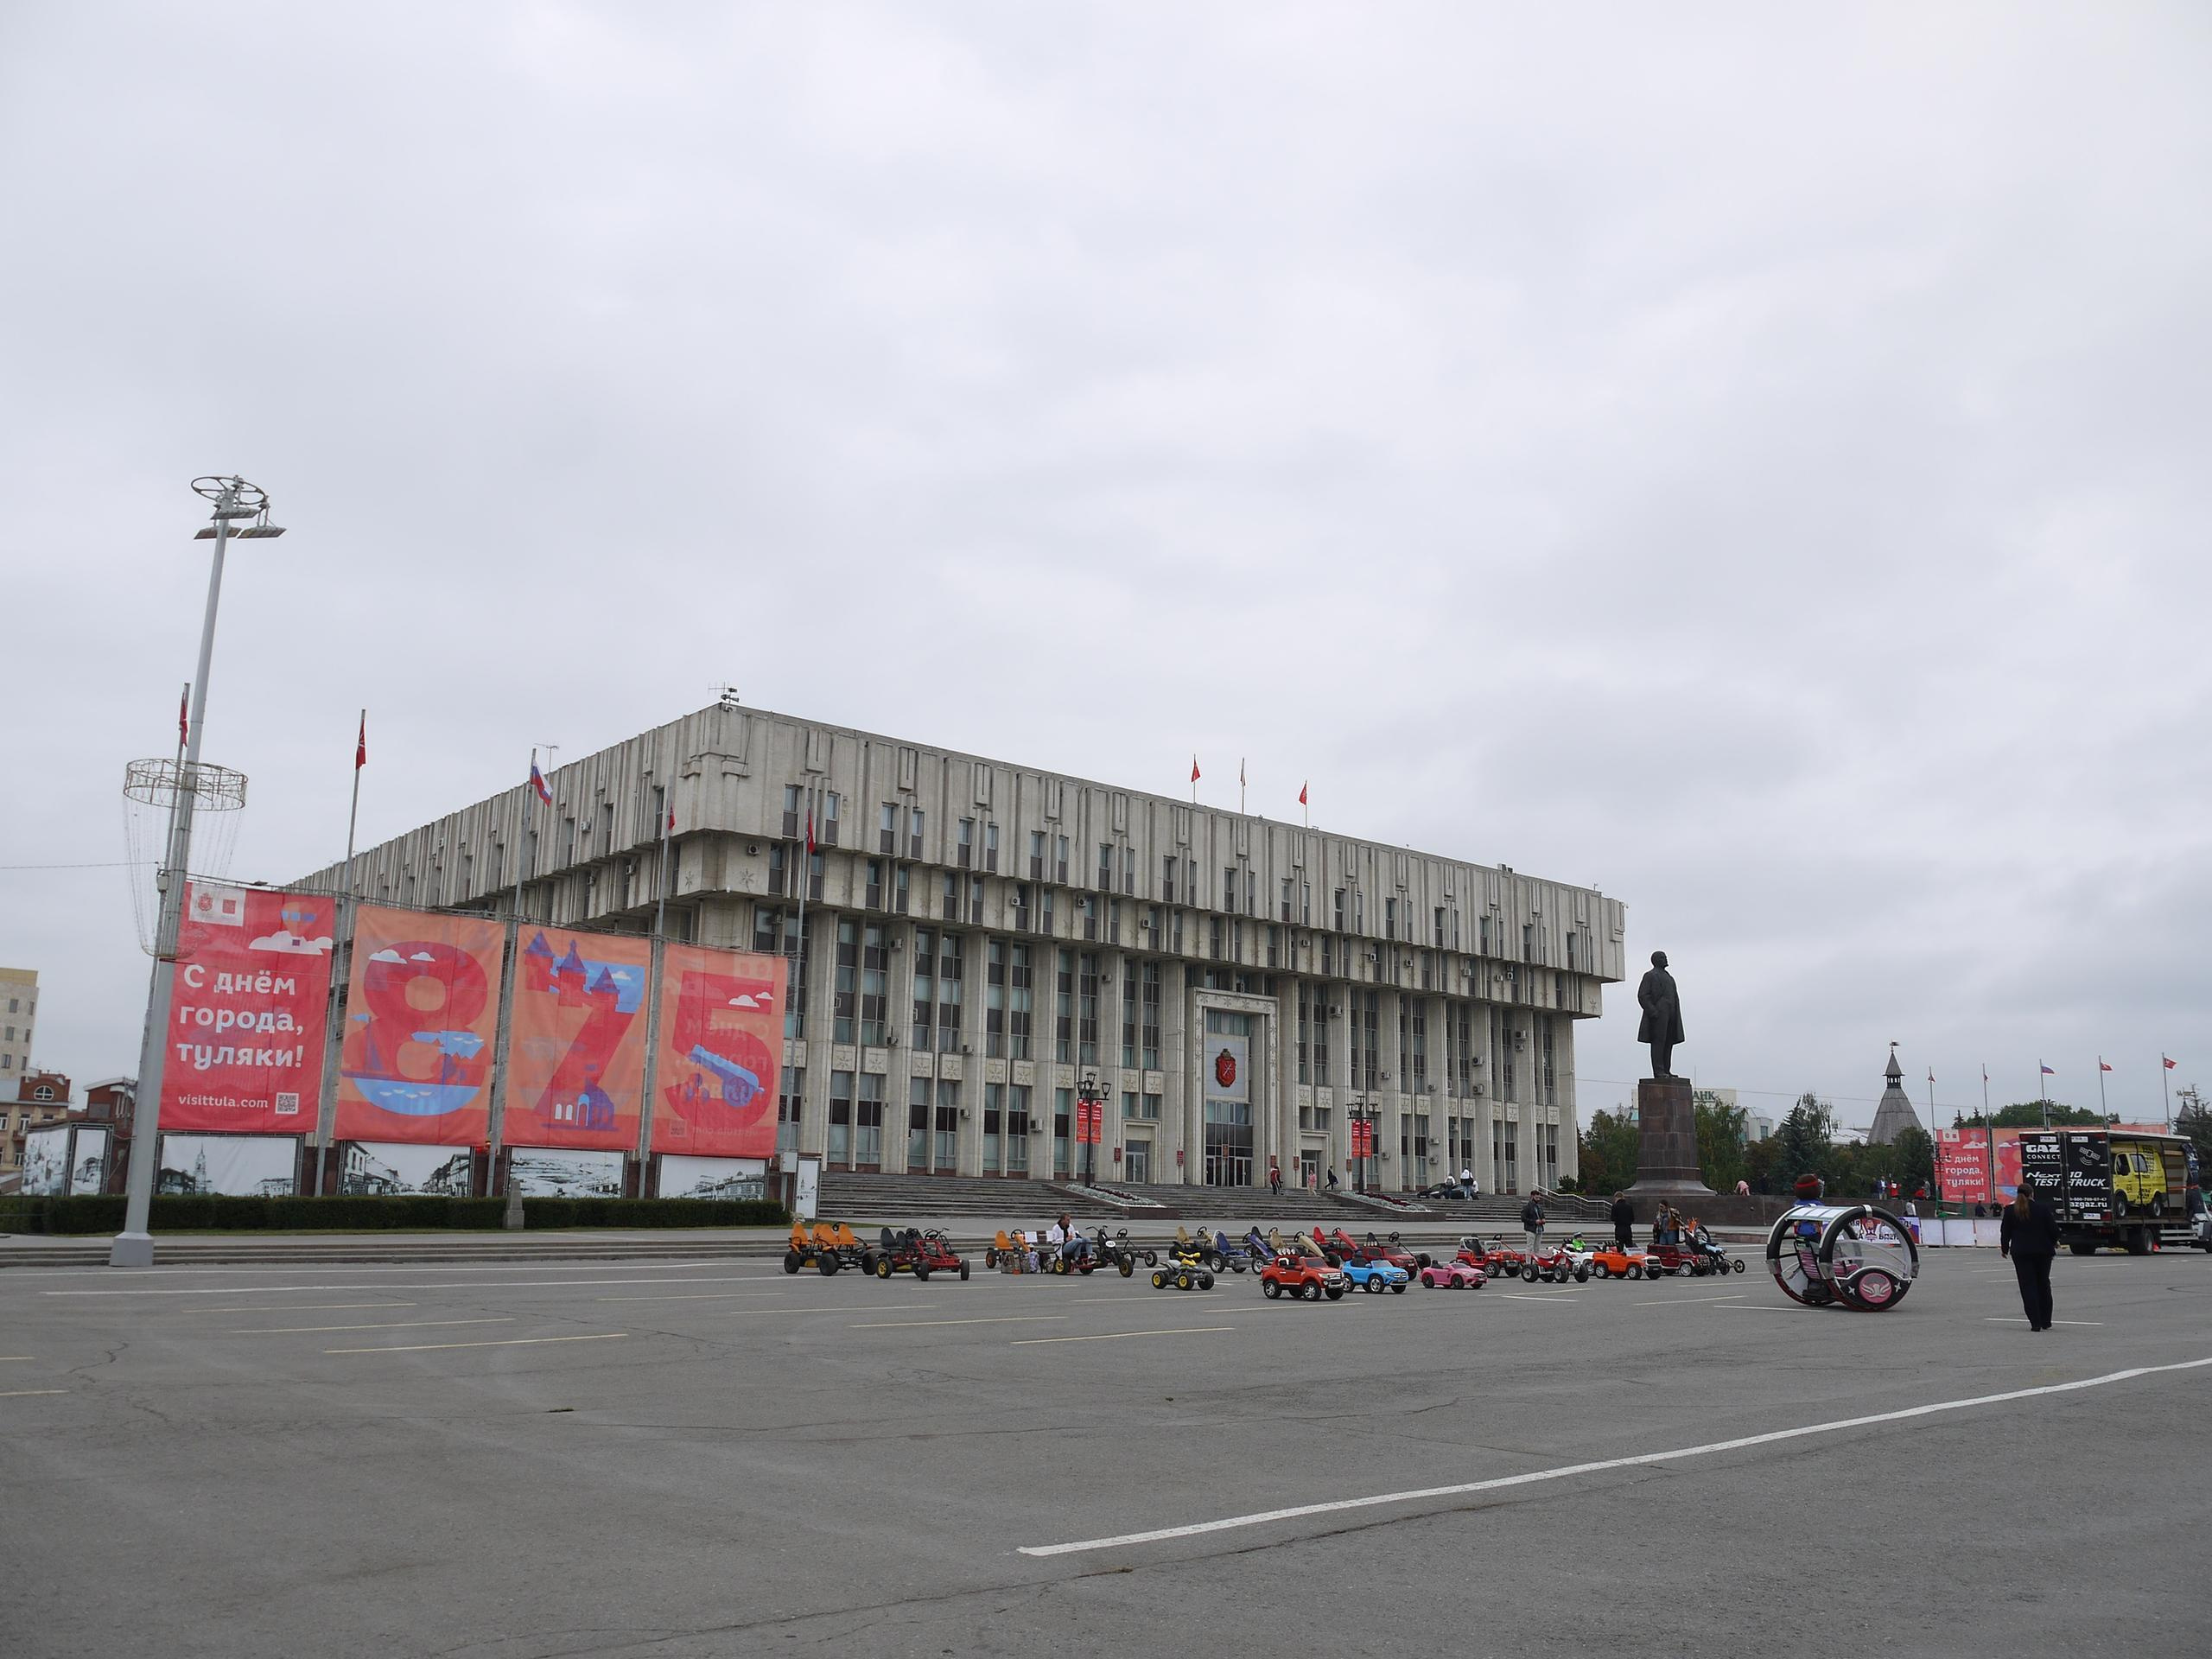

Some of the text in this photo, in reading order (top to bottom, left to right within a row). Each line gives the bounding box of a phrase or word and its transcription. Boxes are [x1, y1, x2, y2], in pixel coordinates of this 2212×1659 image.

[184, 964, 296, 995] С днём
[180, 1006, 304, 1036] города,
[176, 1043, 304, 1071] туляки!
[178, 1094, 269, 1109] visittula.com
[1955, 1154, 1980, 1164] днём
[1945, 1167, 1983, 1176] города,
[1946, 1178, 1985, 1188] туляки!
